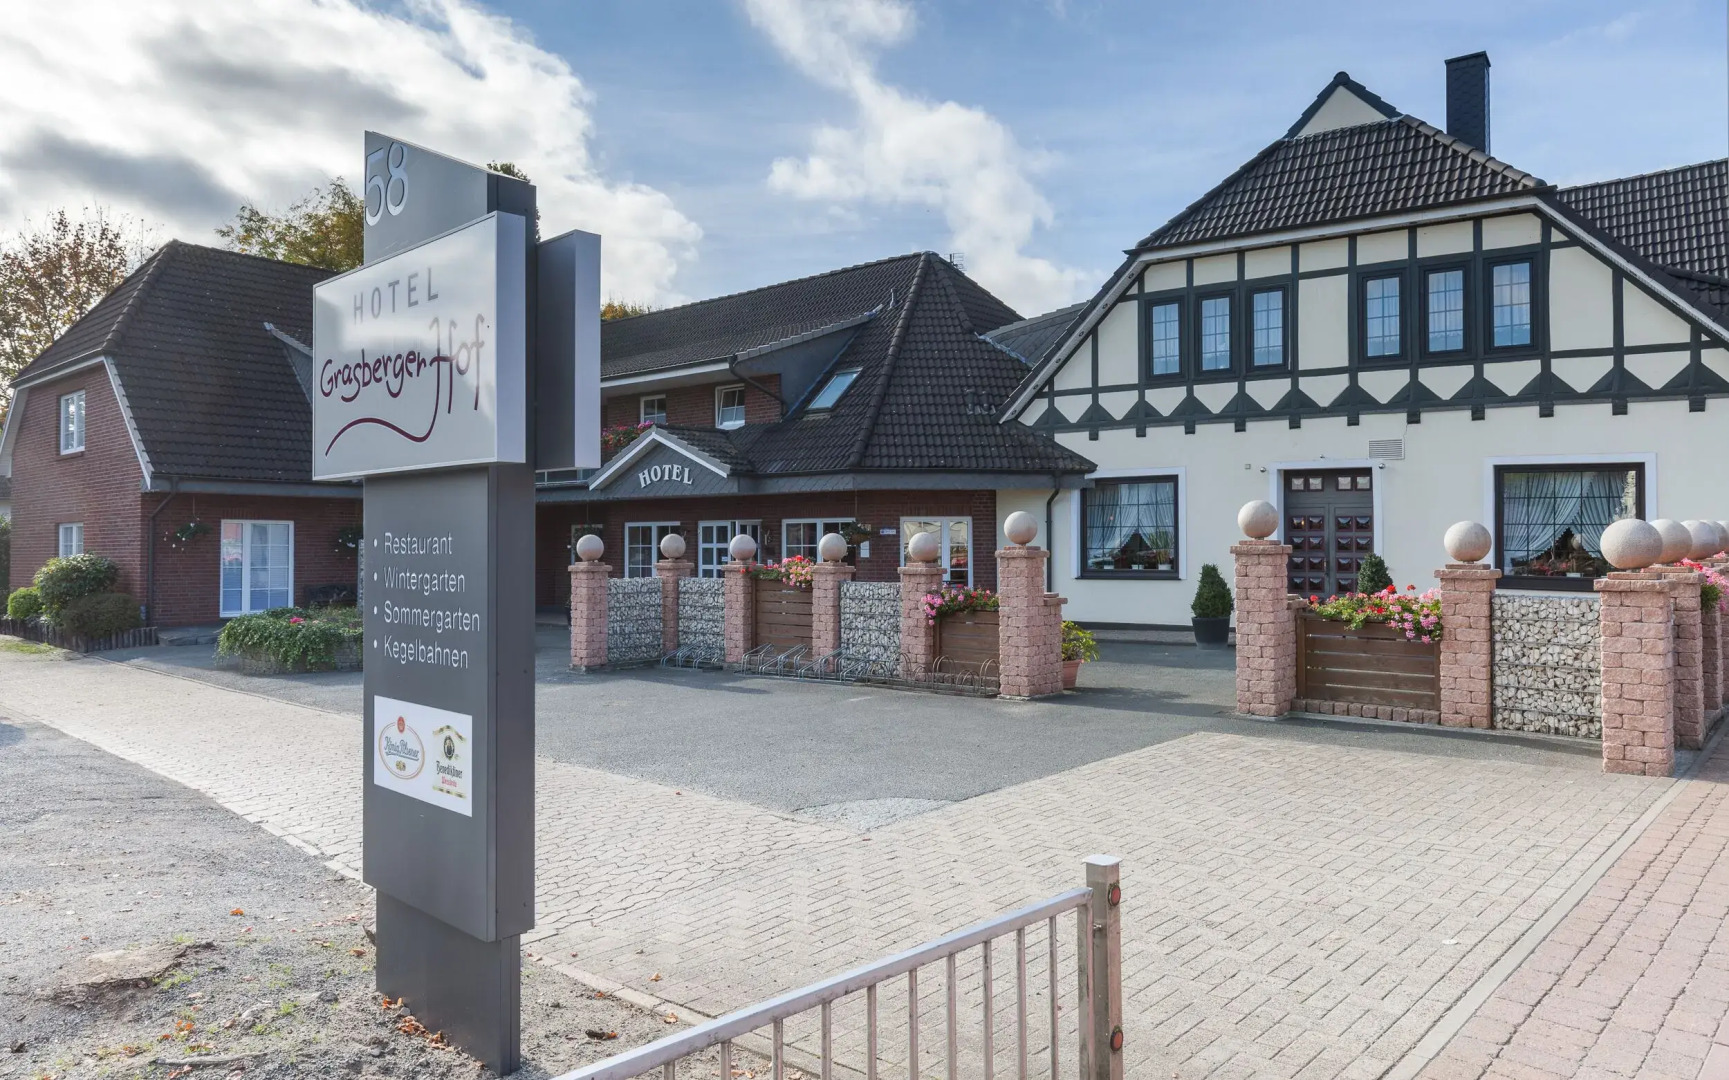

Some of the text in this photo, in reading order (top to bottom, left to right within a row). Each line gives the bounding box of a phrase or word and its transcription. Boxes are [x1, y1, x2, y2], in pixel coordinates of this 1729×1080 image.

[364, 141, 409, 226] 58
[353, 267, 439, 325] HOTEL
[320, 349, 427, 402] Grasberger
[638, 463, 693, 489] HOTEL
[384, 532, 453, 555] Restaurant
[383, 566, 465, 596] Wintergarten
[384, 600, 480, 633] Sommergarten
[384, 635, 468, 669] Kegelbahnen
